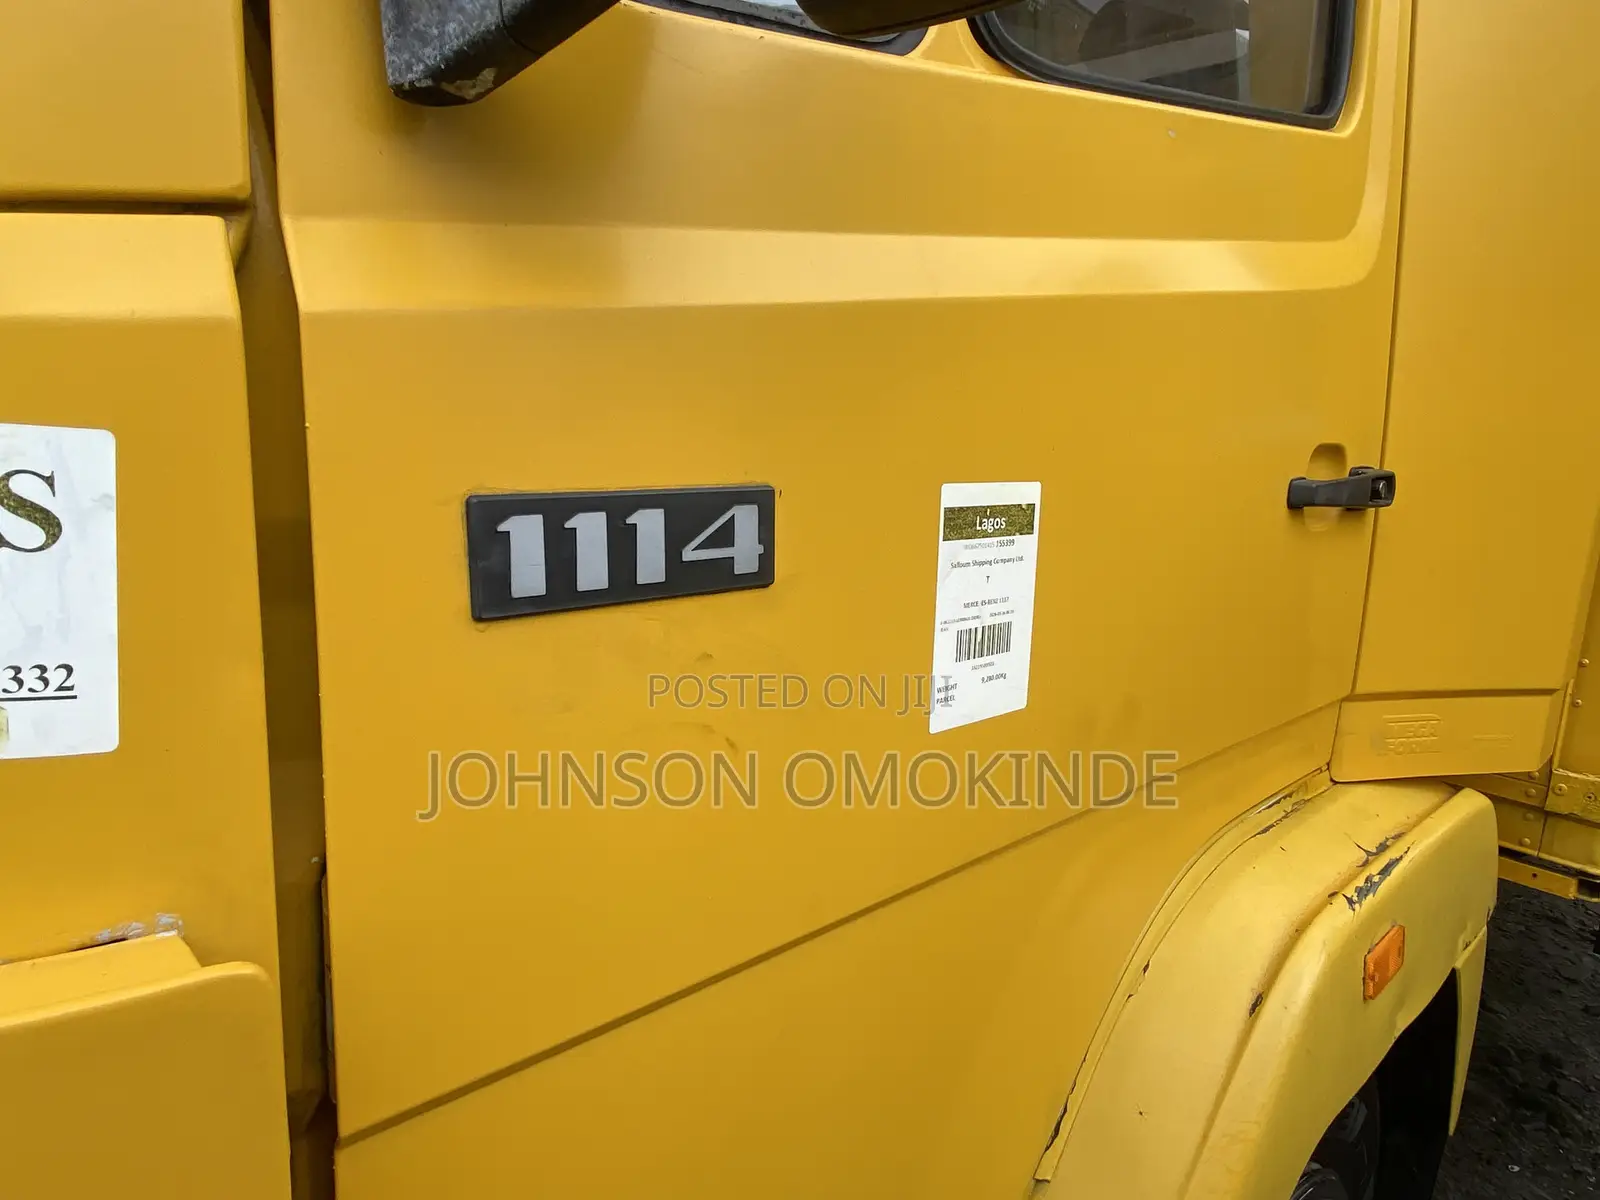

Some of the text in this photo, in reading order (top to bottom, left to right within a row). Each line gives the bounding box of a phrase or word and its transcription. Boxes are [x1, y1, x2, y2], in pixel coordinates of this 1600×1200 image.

[976, 515, 1006, 533] Lagos
[497, 504, 764, 598] 1114
[971, 557, 992, 567] Shipping
[1, 663, 75, 694] 332
[936, 683, 958, 693] WEIGHT
[936, 695, 956, 705] PARCEL
